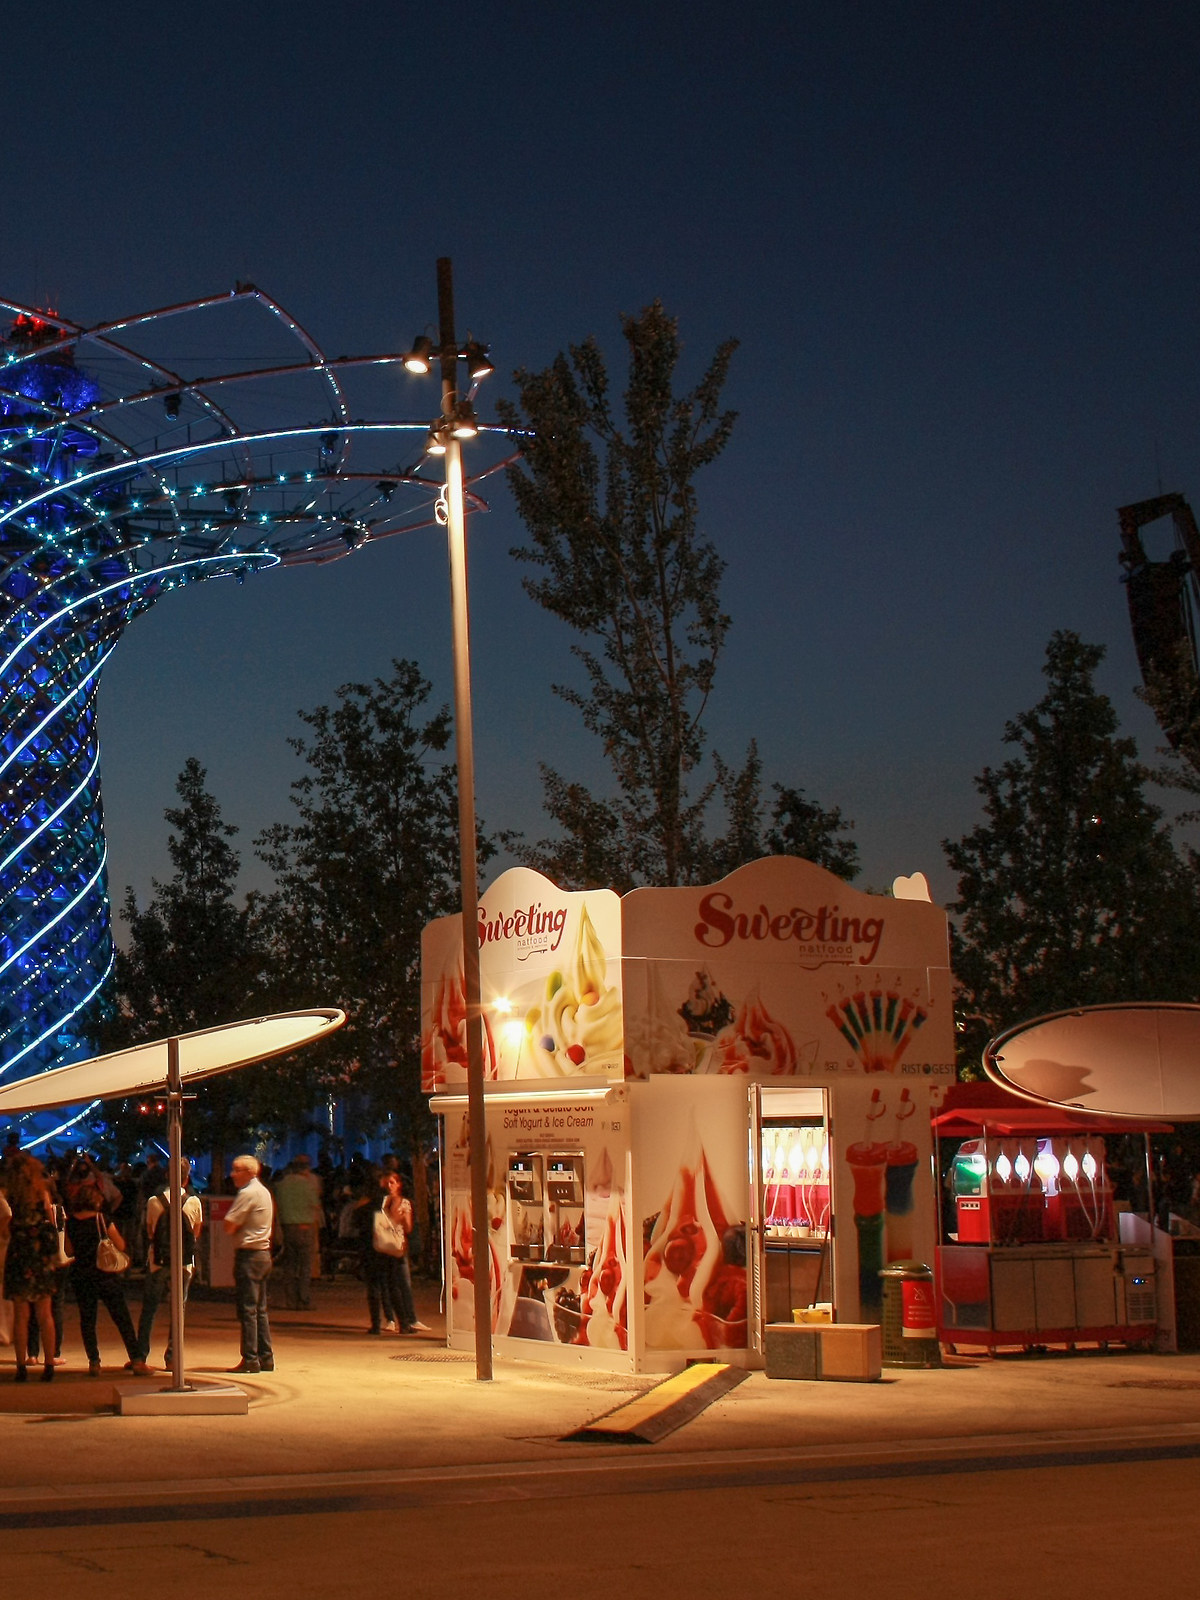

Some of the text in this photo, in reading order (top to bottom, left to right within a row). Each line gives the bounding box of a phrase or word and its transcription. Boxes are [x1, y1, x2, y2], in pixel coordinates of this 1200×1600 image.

[694, 892, 885, 965] Sweeting
[517, 935, 548, 946] natfood
[799, 944, 853, 954] natfood
[503, 1116, 518, 1129] Soft
[519, 1116, 543, 1131] Yogurt
[544, 1116, 550, 1128] &
[552, 1116, 564, 1128] Ice
[566, 1115, 594, 1128] Cream
